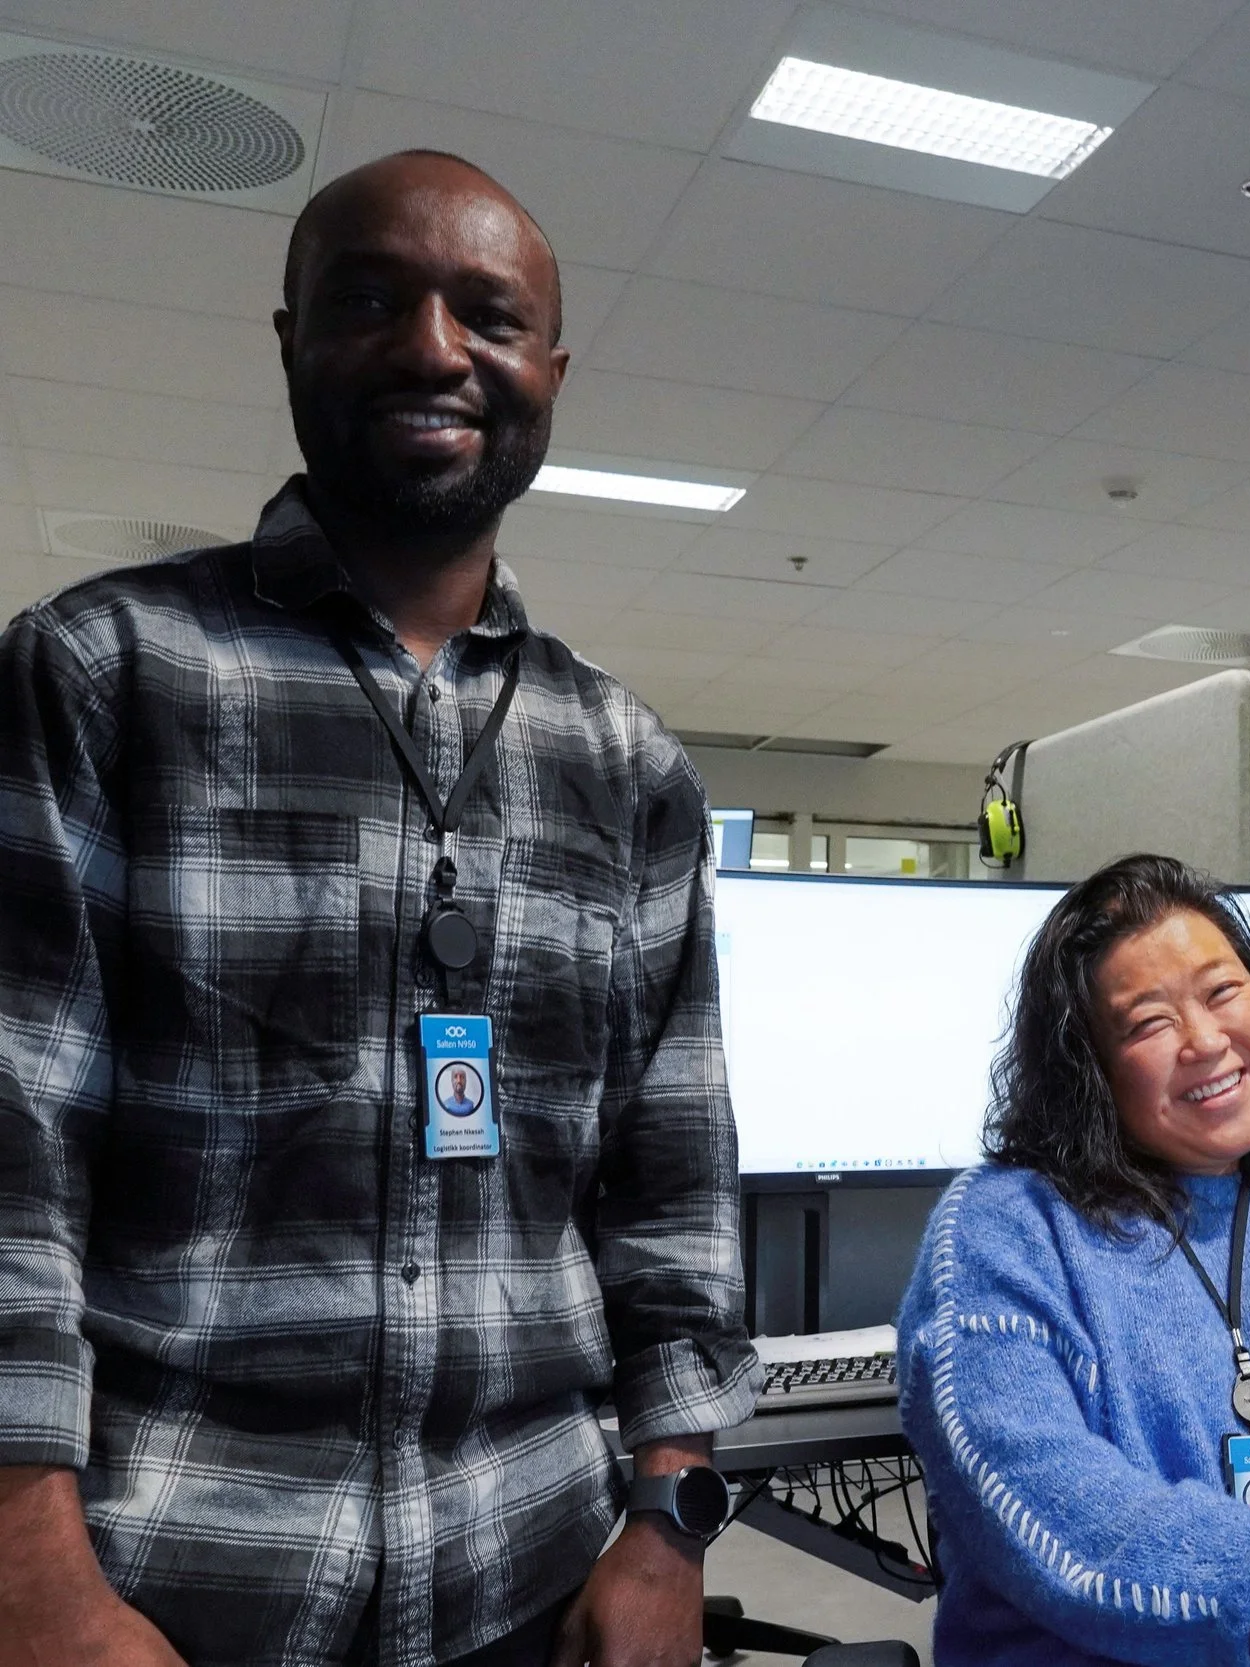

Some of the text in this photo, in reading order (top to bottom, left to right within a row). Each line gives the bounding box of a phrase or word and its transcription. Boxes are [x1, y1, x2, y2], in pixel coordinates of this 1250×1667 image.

[436, 1039, 477, 1049] Salten N950
[439, 1128, 463, 1137] Stephen
